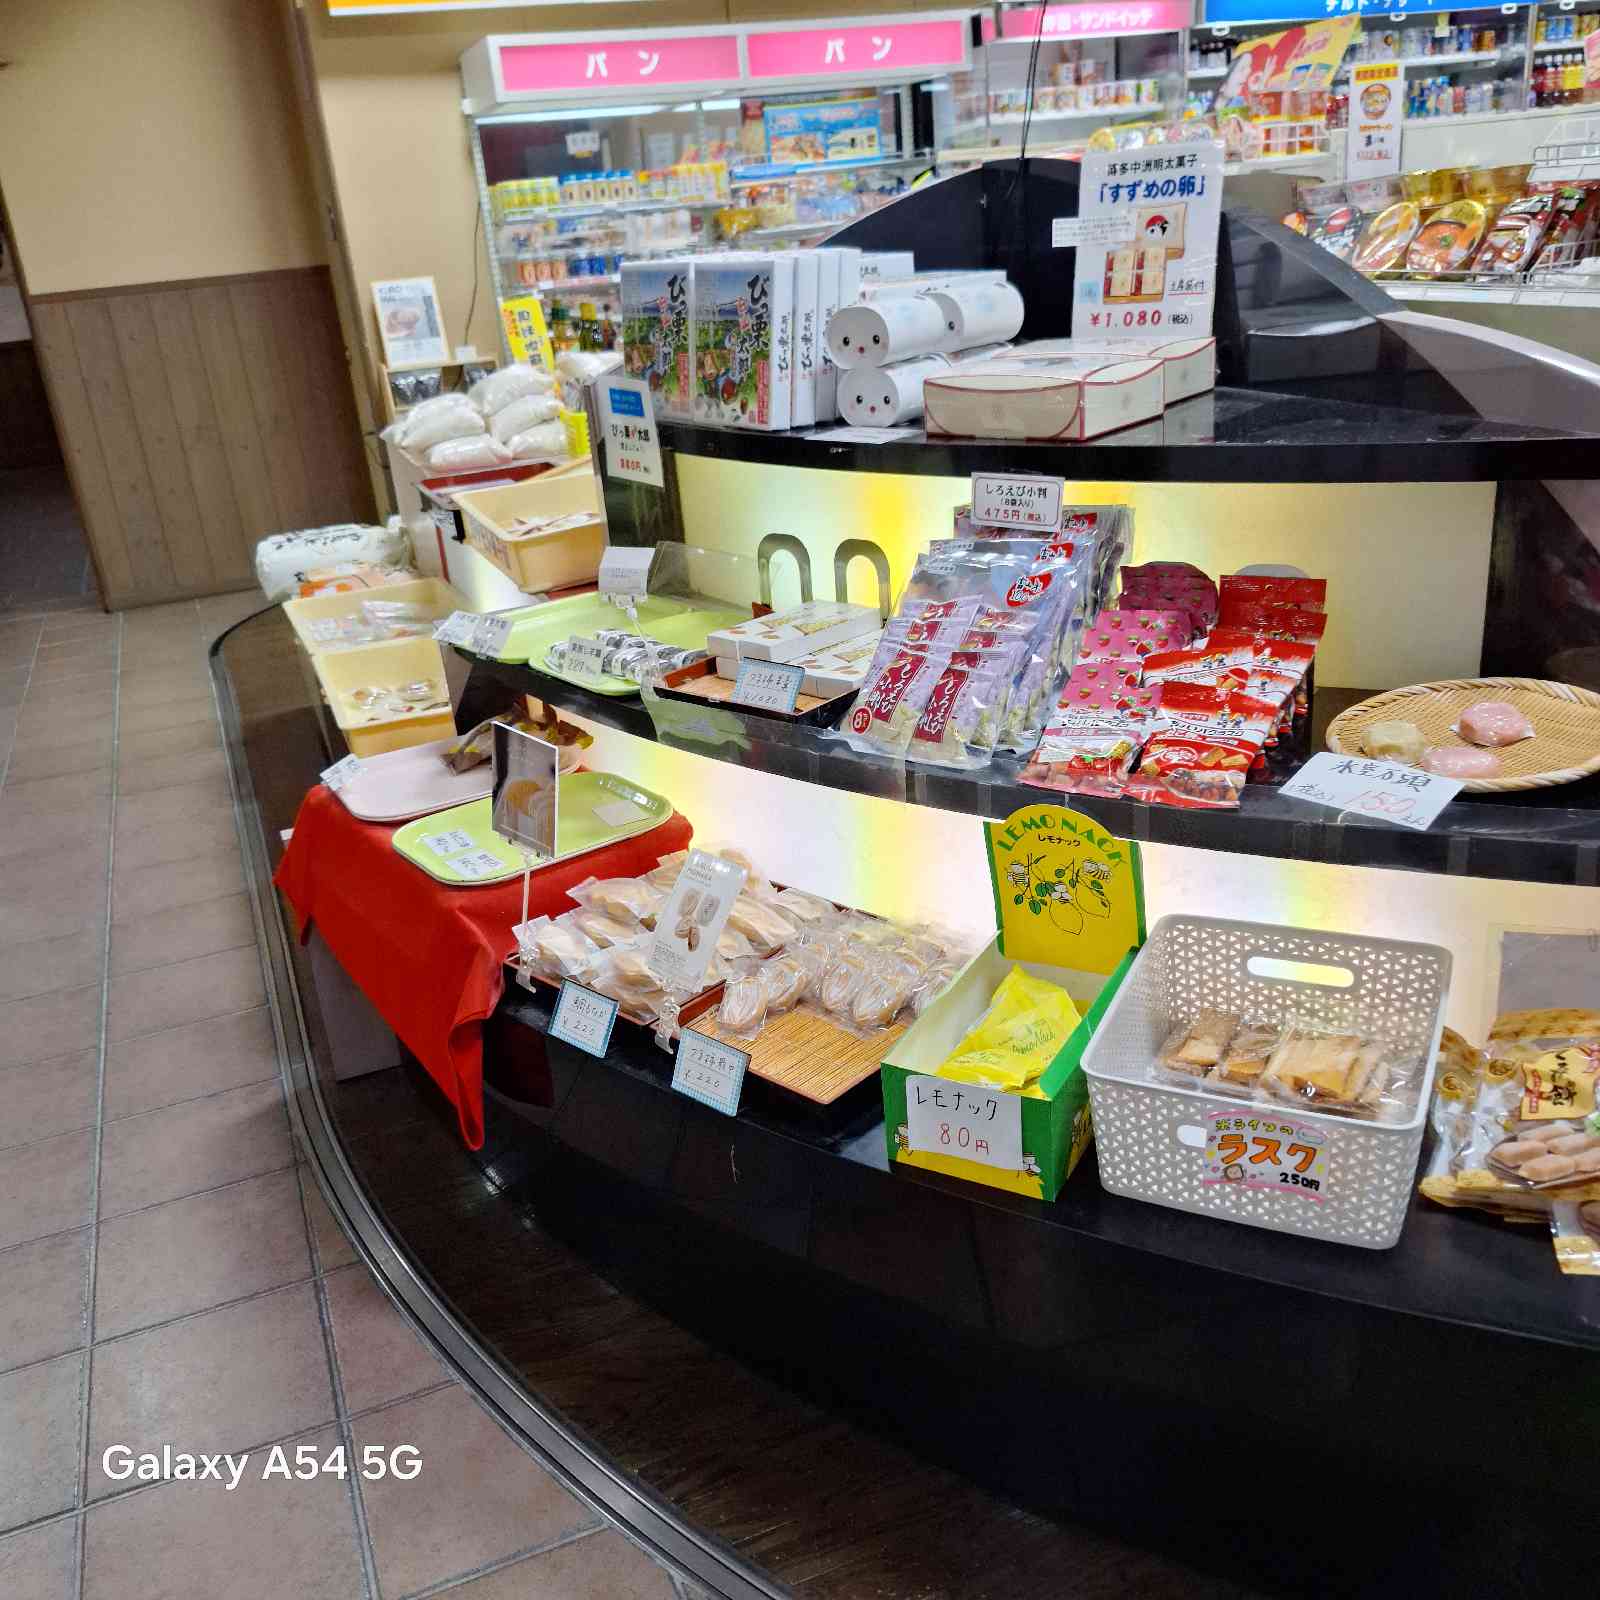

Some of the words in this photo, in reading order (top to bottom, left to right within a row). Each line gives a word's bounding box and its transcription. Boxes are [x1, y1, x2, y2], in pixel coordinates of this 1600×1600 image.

[825, 36, 893, 65] パン
[585, 51, 660, 79] パン
[986, 482, 1048, 499] しろえび小判
[985, 507, 1020, 521] 475円
[1038, 834, 1081, 847] レモナック
[915, 1086, 1000, 1121] レモナック
[938, 1123, 990, 1155] 80円
[1217, 1134, 1317, 1173] ラスク
[1280, 1172, 1320, 1191] 250円
